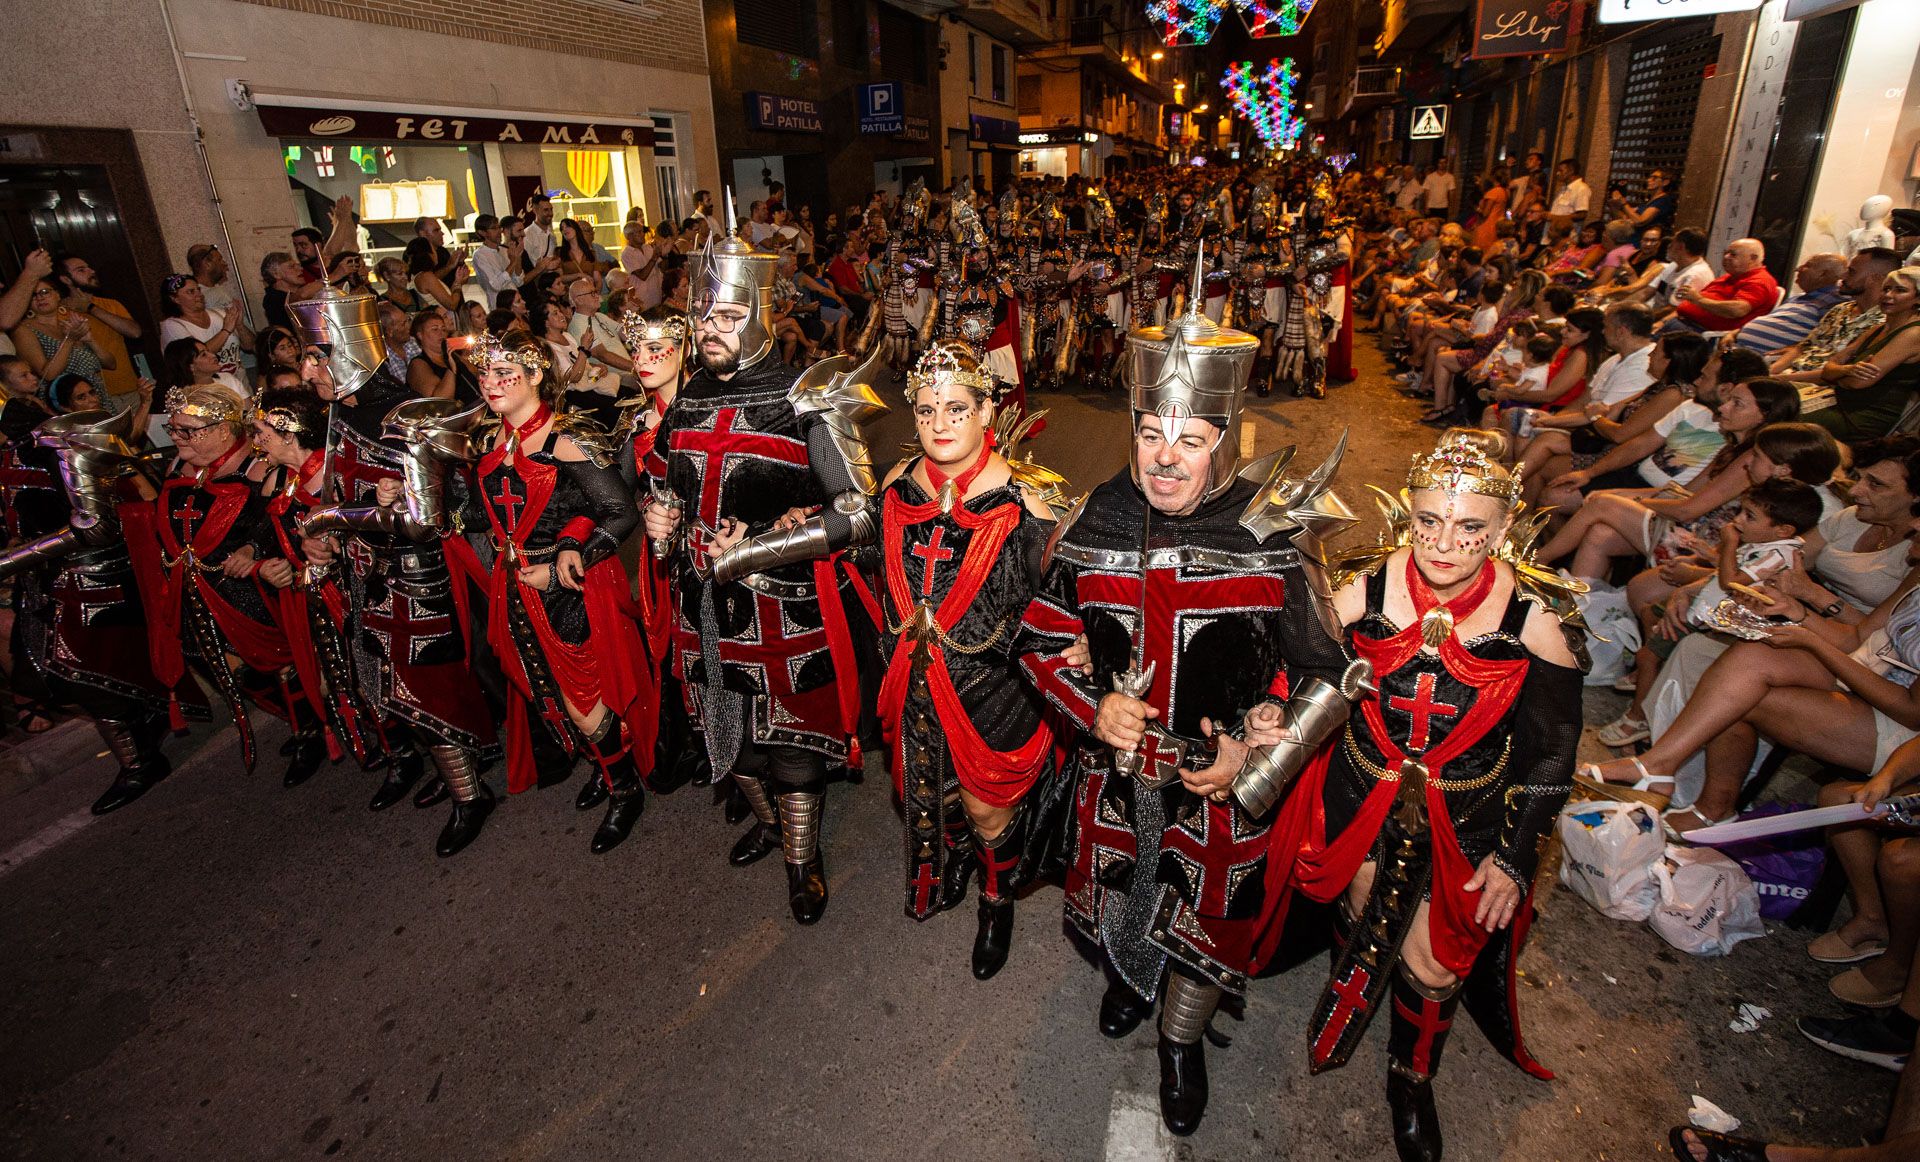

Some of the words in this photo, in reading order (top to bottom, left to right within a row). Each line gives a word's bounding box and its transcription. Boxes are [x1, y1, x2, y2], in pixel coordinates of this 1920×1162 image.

[1481, 11, 1561, 43] Lily
[780, 98, 817, 115] HOTEL
[874, 90, 890, 111] P
[777, 114, 823, 132] PATILLA
[861, 122, 902, 134] PATILLA
[498, 123, 523, 143] A
